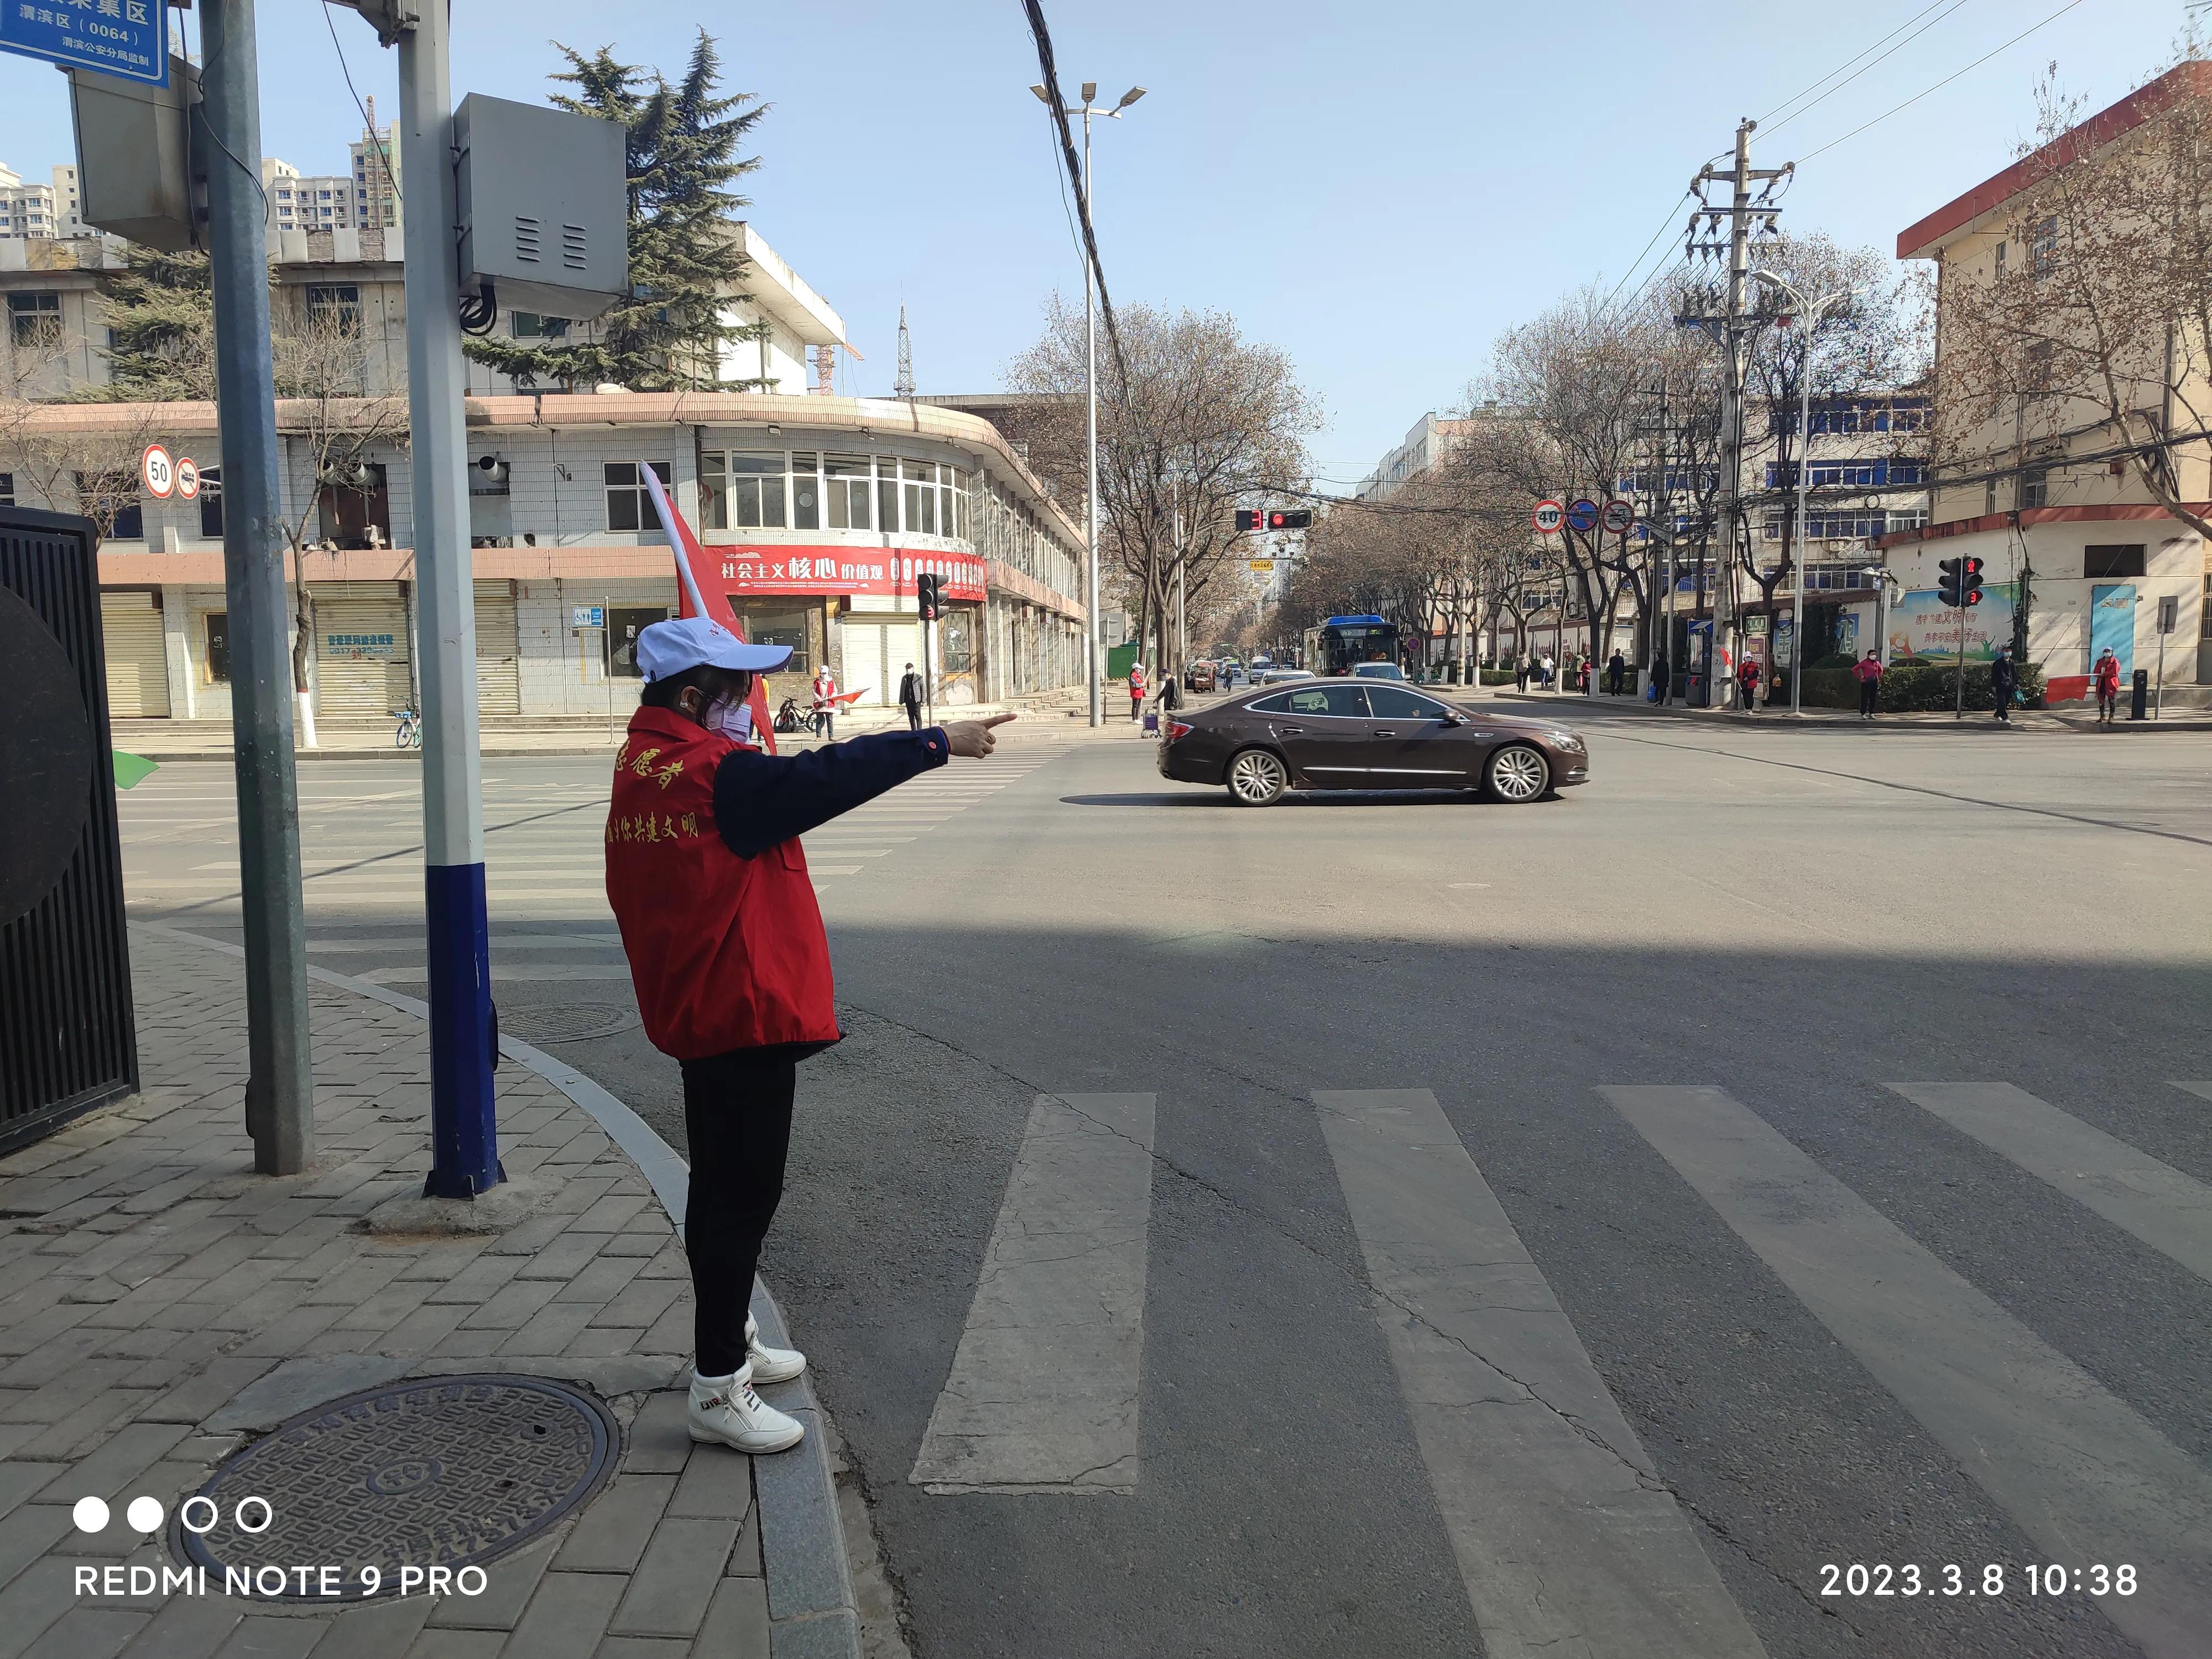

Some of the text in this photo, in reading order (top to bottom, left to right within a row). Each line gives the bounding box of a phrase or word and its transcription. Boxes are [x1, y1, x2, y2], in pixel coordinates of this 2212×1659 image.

[49, 0, 149, 25] 集区
[151, 461, 168, 482] 50
[1252, 510, 1262, 530] 3
[1538, 512, 1558, 523] 40
